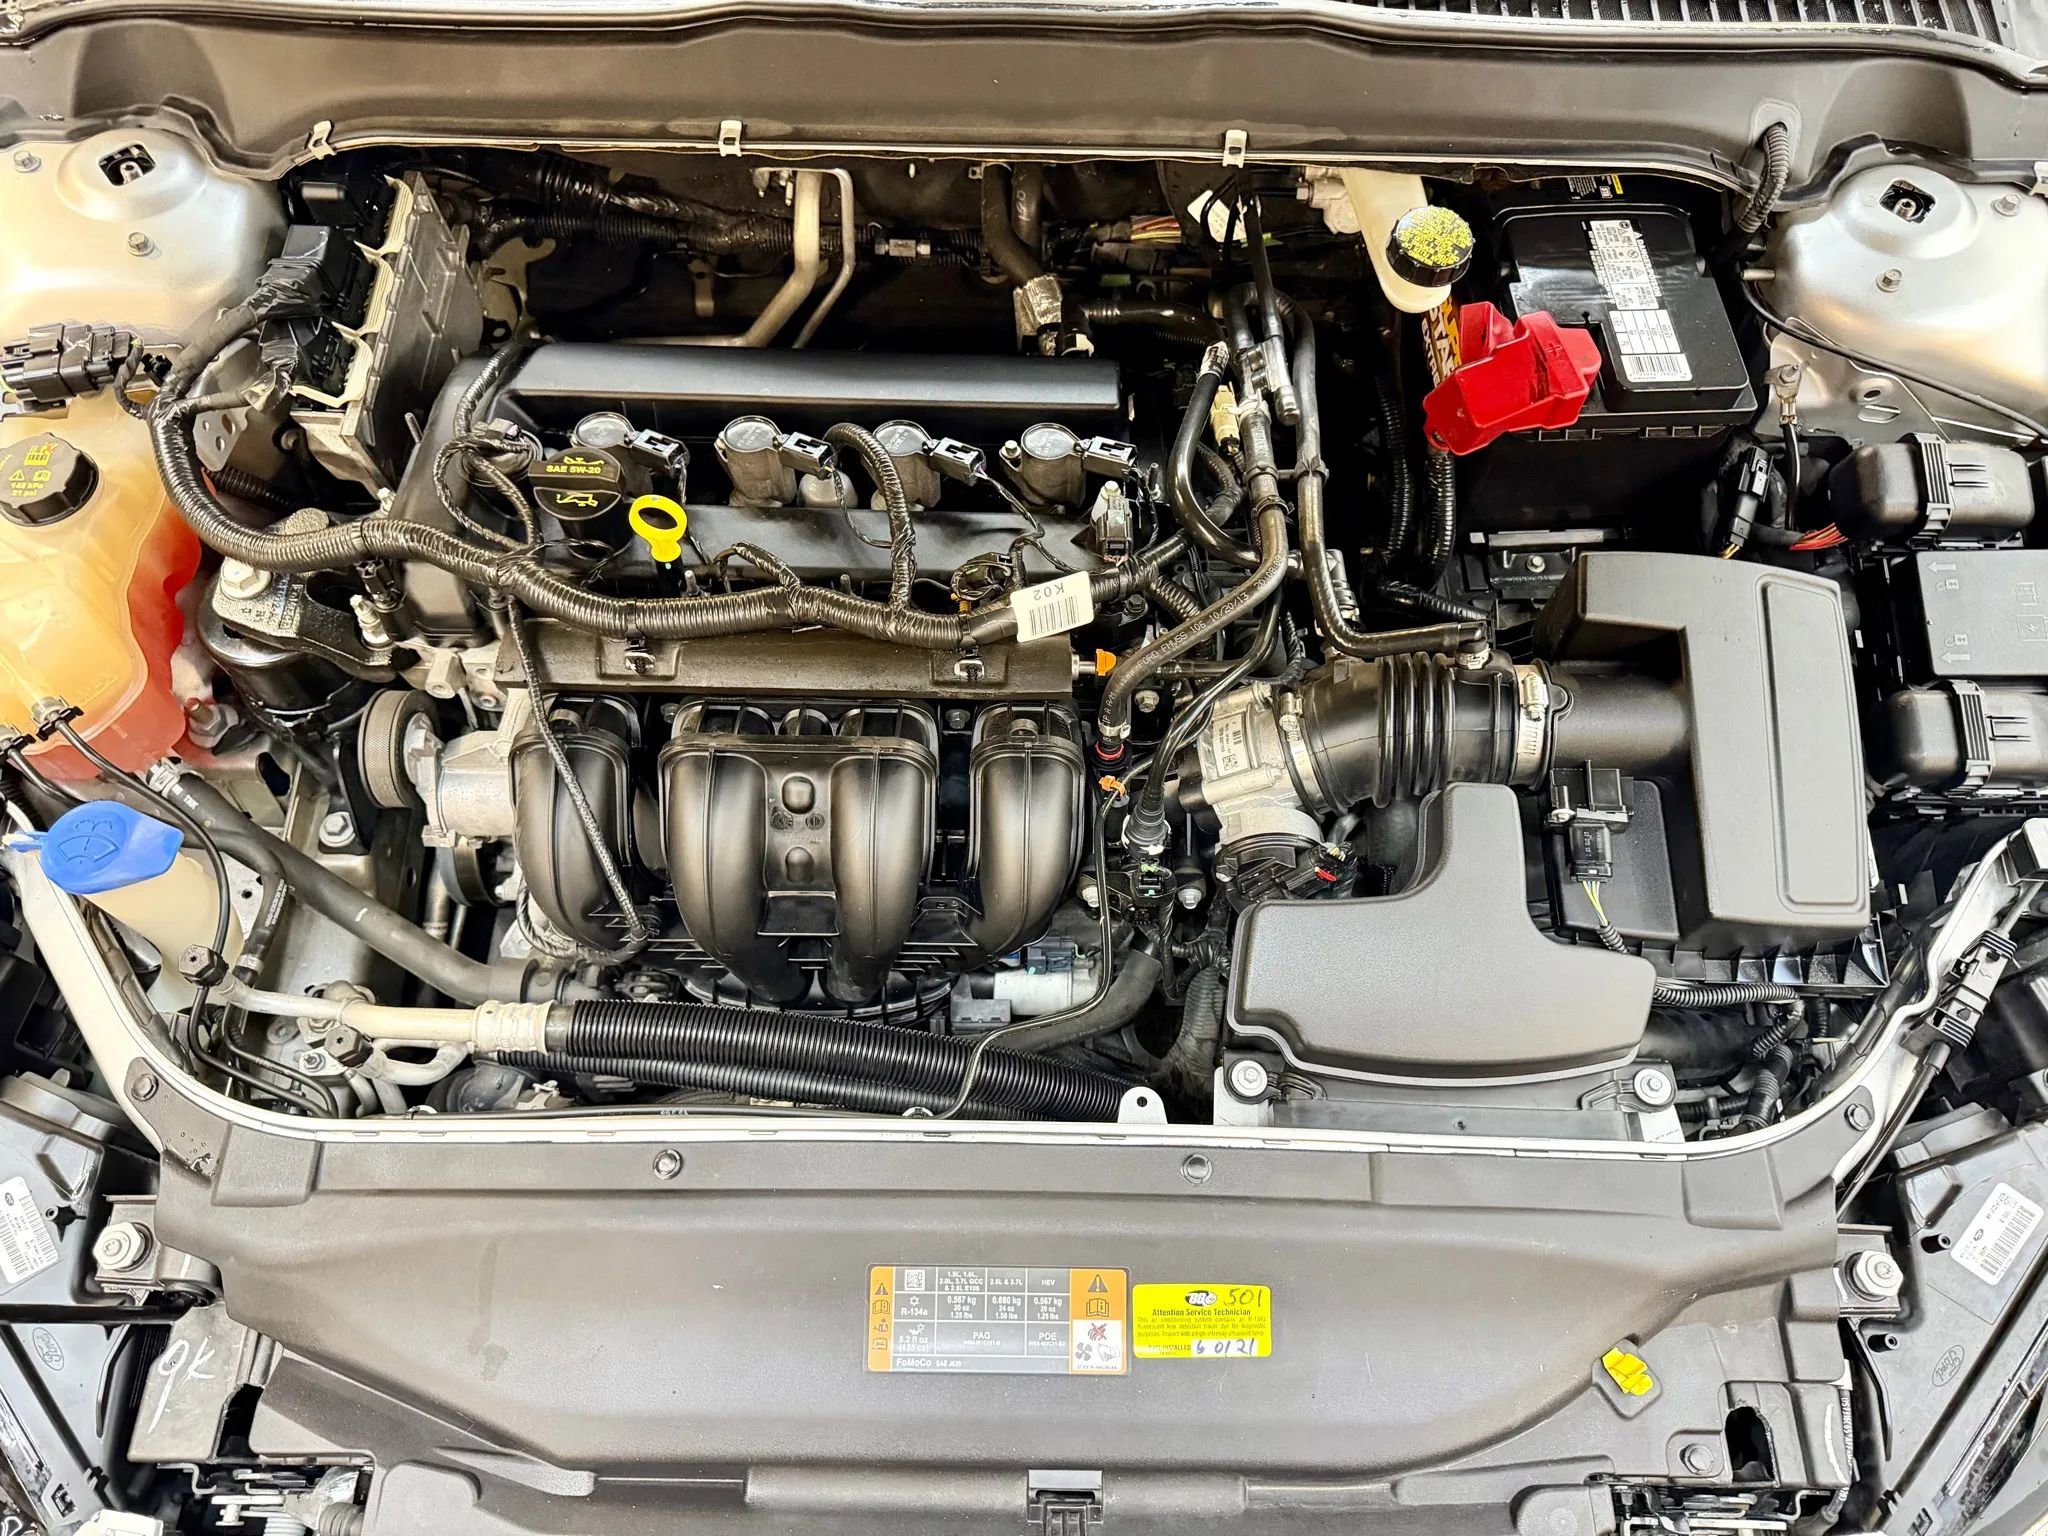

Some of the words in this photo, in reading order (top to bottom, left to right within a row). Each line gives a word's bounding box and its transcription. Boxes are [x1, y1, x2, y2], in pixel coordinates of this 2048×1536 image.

[545, 464, 568, 473] SAE
[569, 465, 602, 474] 5W-20
[1032, 582, 1065, 601] K02
[1136, 649, 1160, 670] FORD
[1161, 631, 1189, 653] FMVSS
[1189, 620, 1207, 634] 106
[1208, 591, 1251, 622] 10/20/13
[967, 1295, 977, 1306] kg
[1012, 1296, 1022, 1307] kg
[1053, 1297, 1063, 1307] kg
[900, 1308, 928, 1316] R-134a
[1152, 1308, 1185, 1316] Attention
[1186, 1308, 1212, 1317] Service
[1213, 1308, 1251, 1317] Technician
[919, 1336, 929, 1344] oz
[972, 1331, 991, 1340] PAG
[1038, 1332, 1057, 1341] POE
[896, 1358, 932, 1367] FoMoCo
